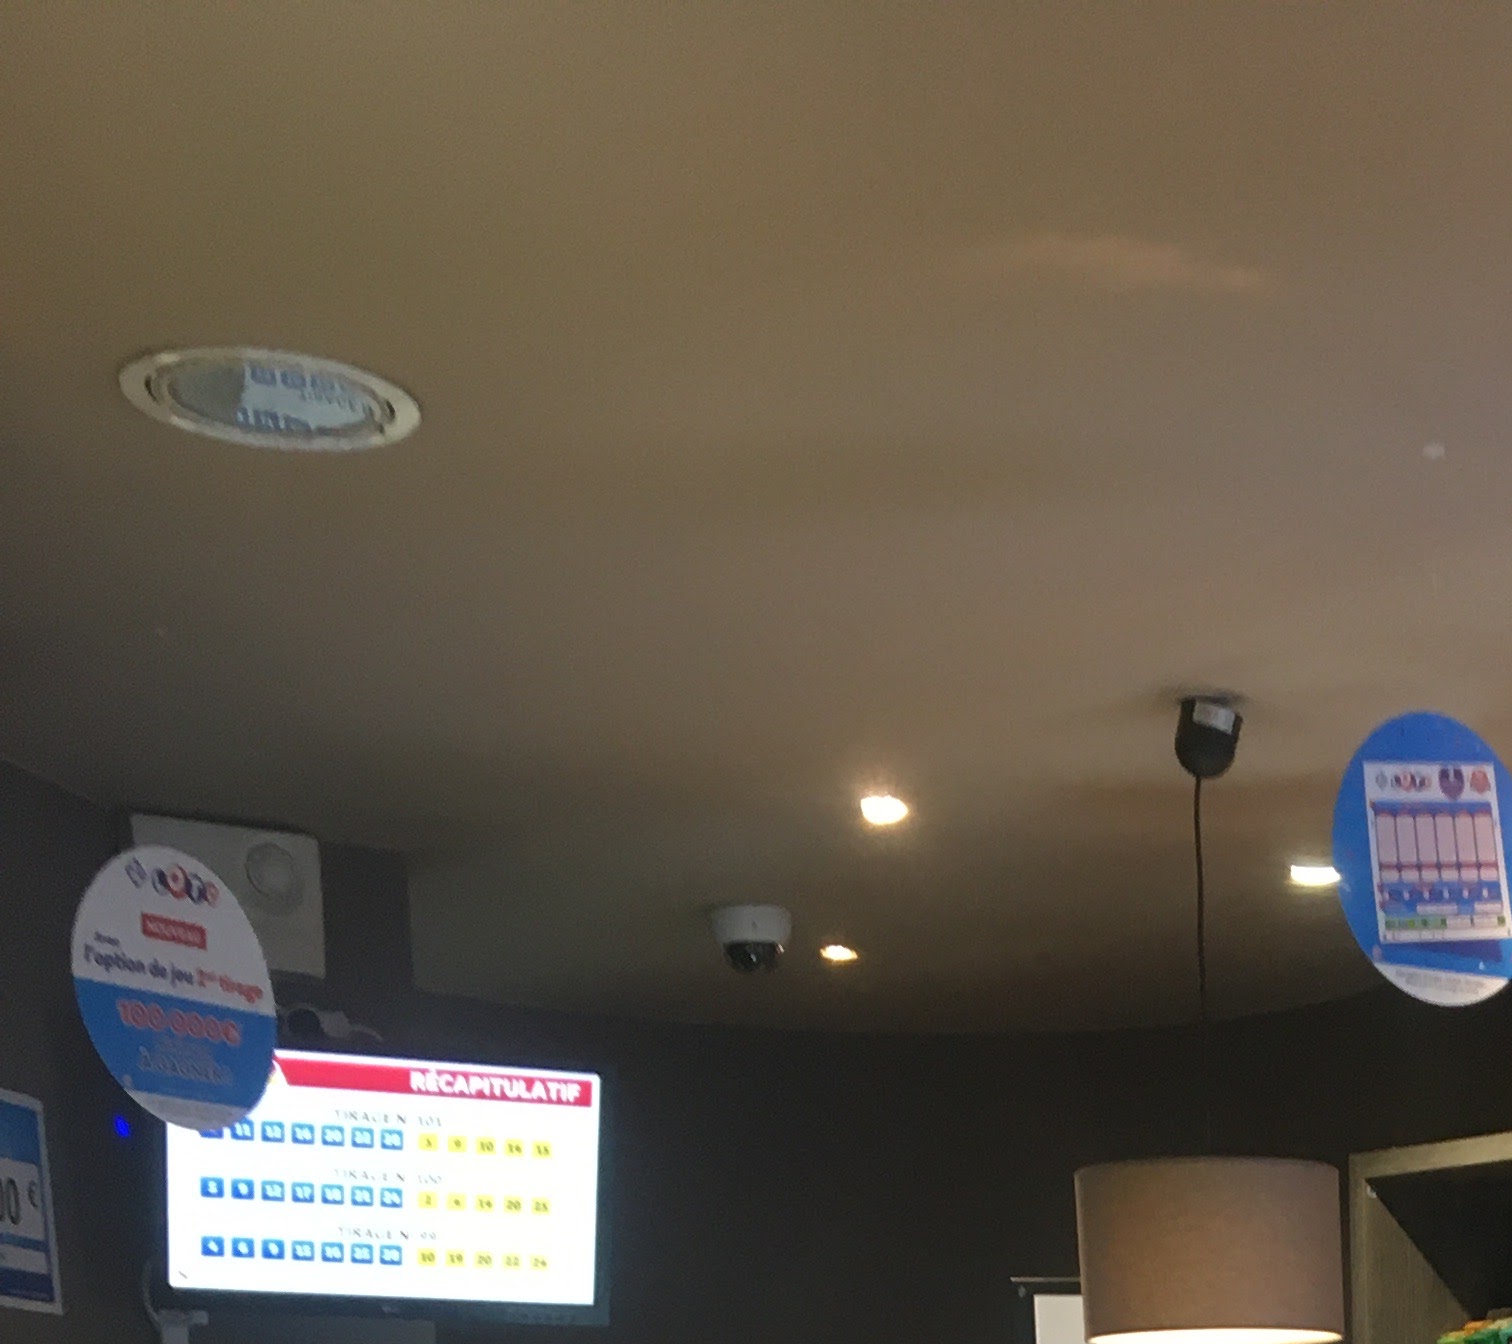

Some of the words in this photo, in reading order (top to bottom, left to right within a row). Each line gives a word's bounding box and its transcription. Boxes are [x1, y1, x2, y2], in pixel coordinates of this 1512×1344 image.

[148, 957, 167, 978] de
[170, 962, 193, 988] jeu
[410, 1068, 581, 1103] RÉCAPITULATIF
